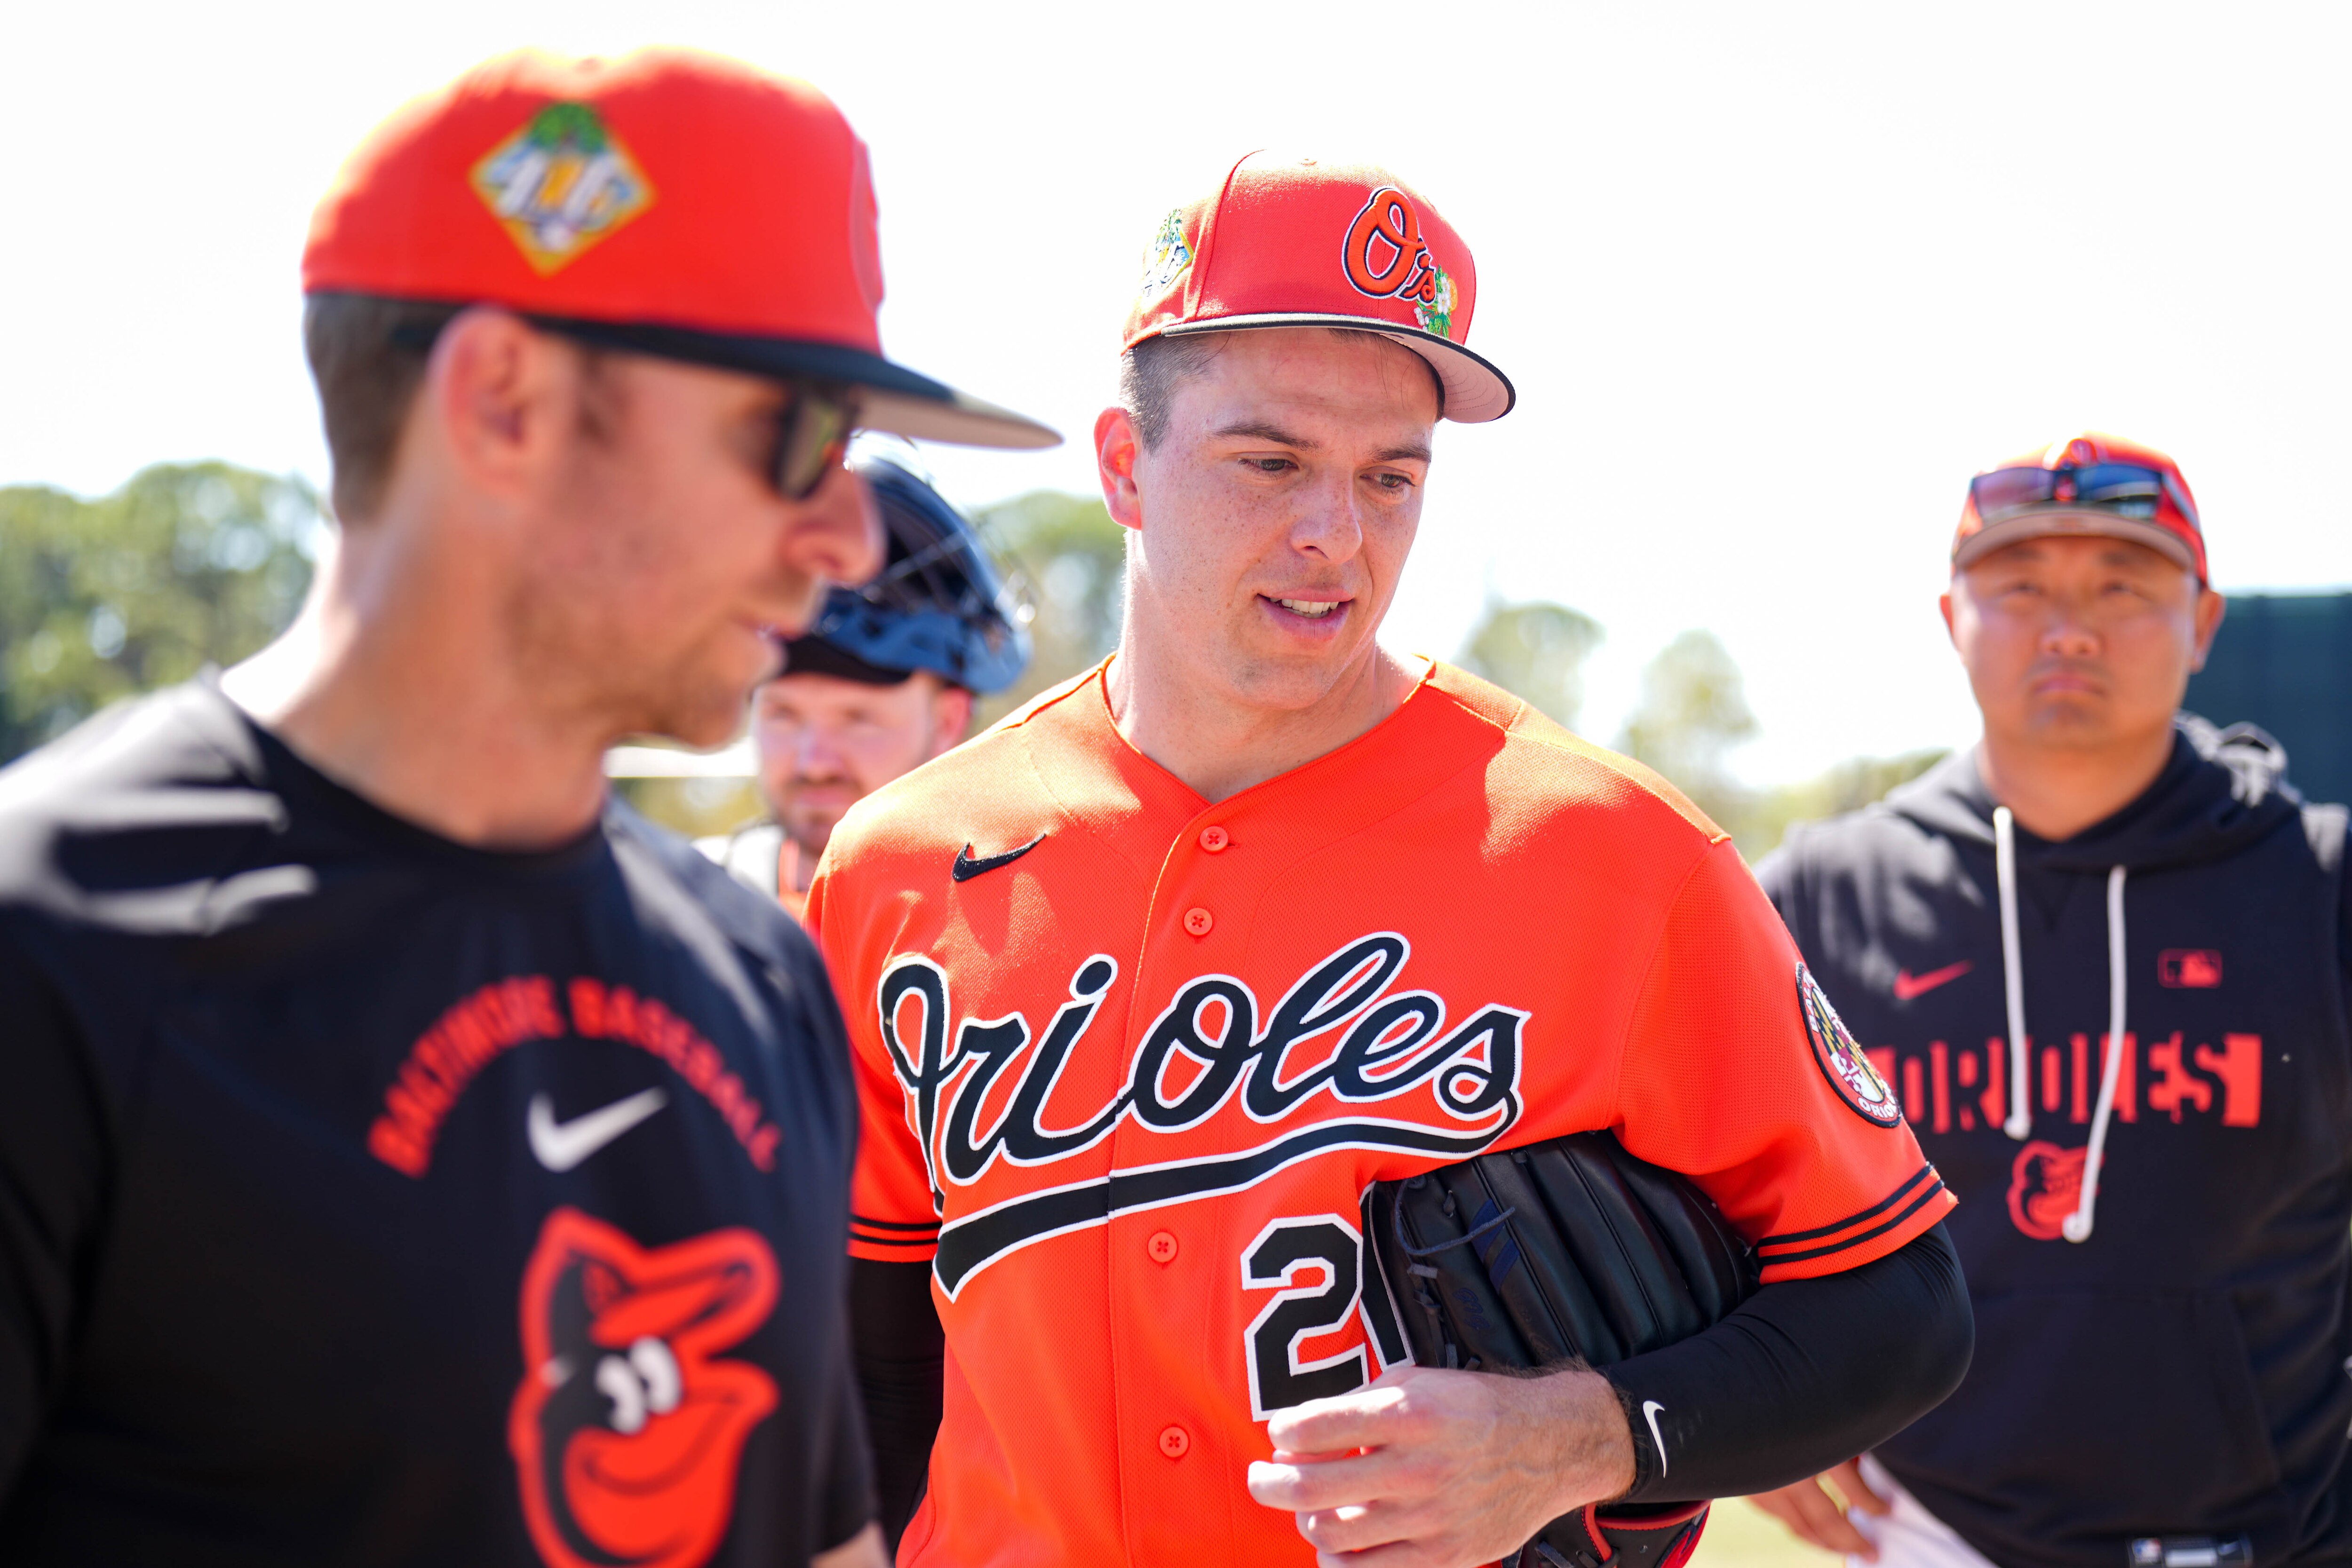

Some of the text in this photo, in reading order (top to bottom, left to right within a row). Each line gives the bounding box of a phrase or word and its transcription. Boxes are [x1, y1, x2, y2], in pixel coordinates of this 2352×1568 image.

[568, 976, 781, 1175] BASEBALL
[878, 931, 1531, 1219] Orioles
[1890, 1031, 2234, 1134] OROLES
